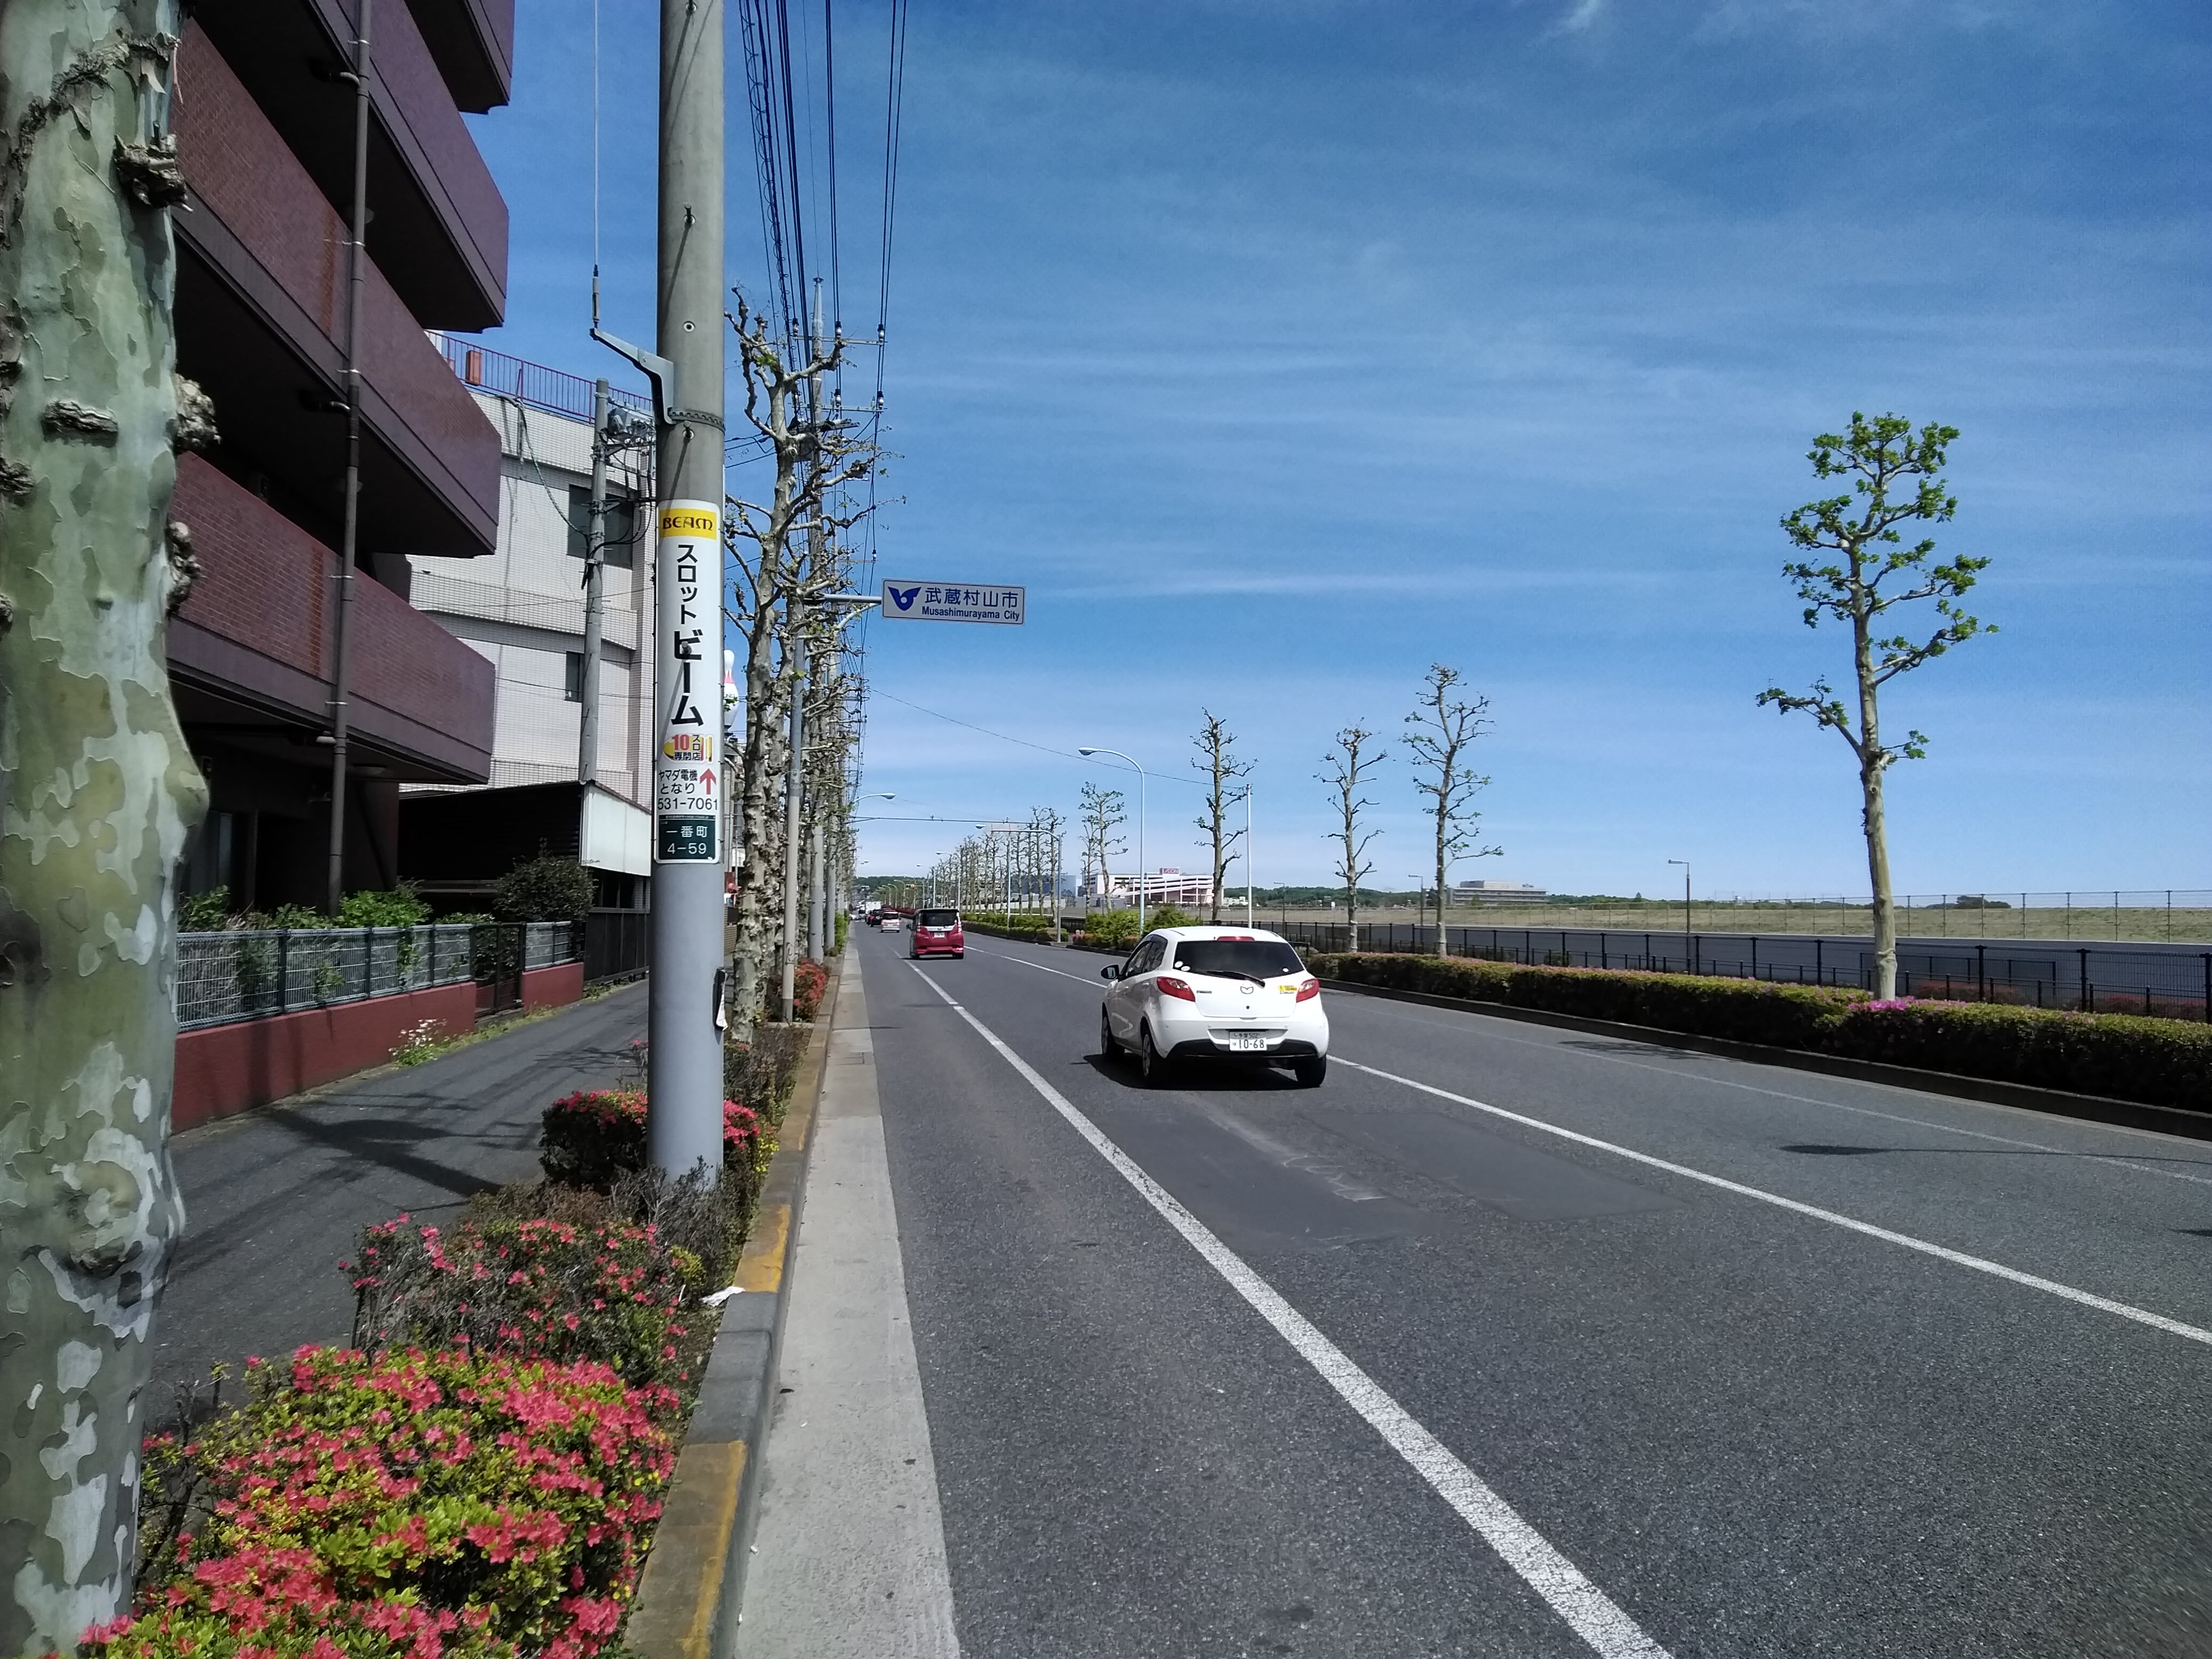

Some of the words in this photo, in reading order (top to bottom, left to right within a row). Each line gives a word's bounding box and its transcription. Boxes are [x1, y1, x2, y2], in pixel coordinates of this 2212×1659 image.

[663, 516, 713, 531] BEAM
[925, 587, 1018, 608] 武蔵村山市
[922, 606, 1000, 619] Musashimurayama
[1004, 610, 1020, 621] City
[674, 752, 701, 760] 専門店
[659, 769, 698, 781] ヤマダ電機
[660, 783, 694, 794] となり
[657, 798, 717, 810] 531-7061
[666, 826, 708, 837] 一番町
[667, 843, 707, 854] 4-59
[1239, 1039, 1264, 1049] 10-68
